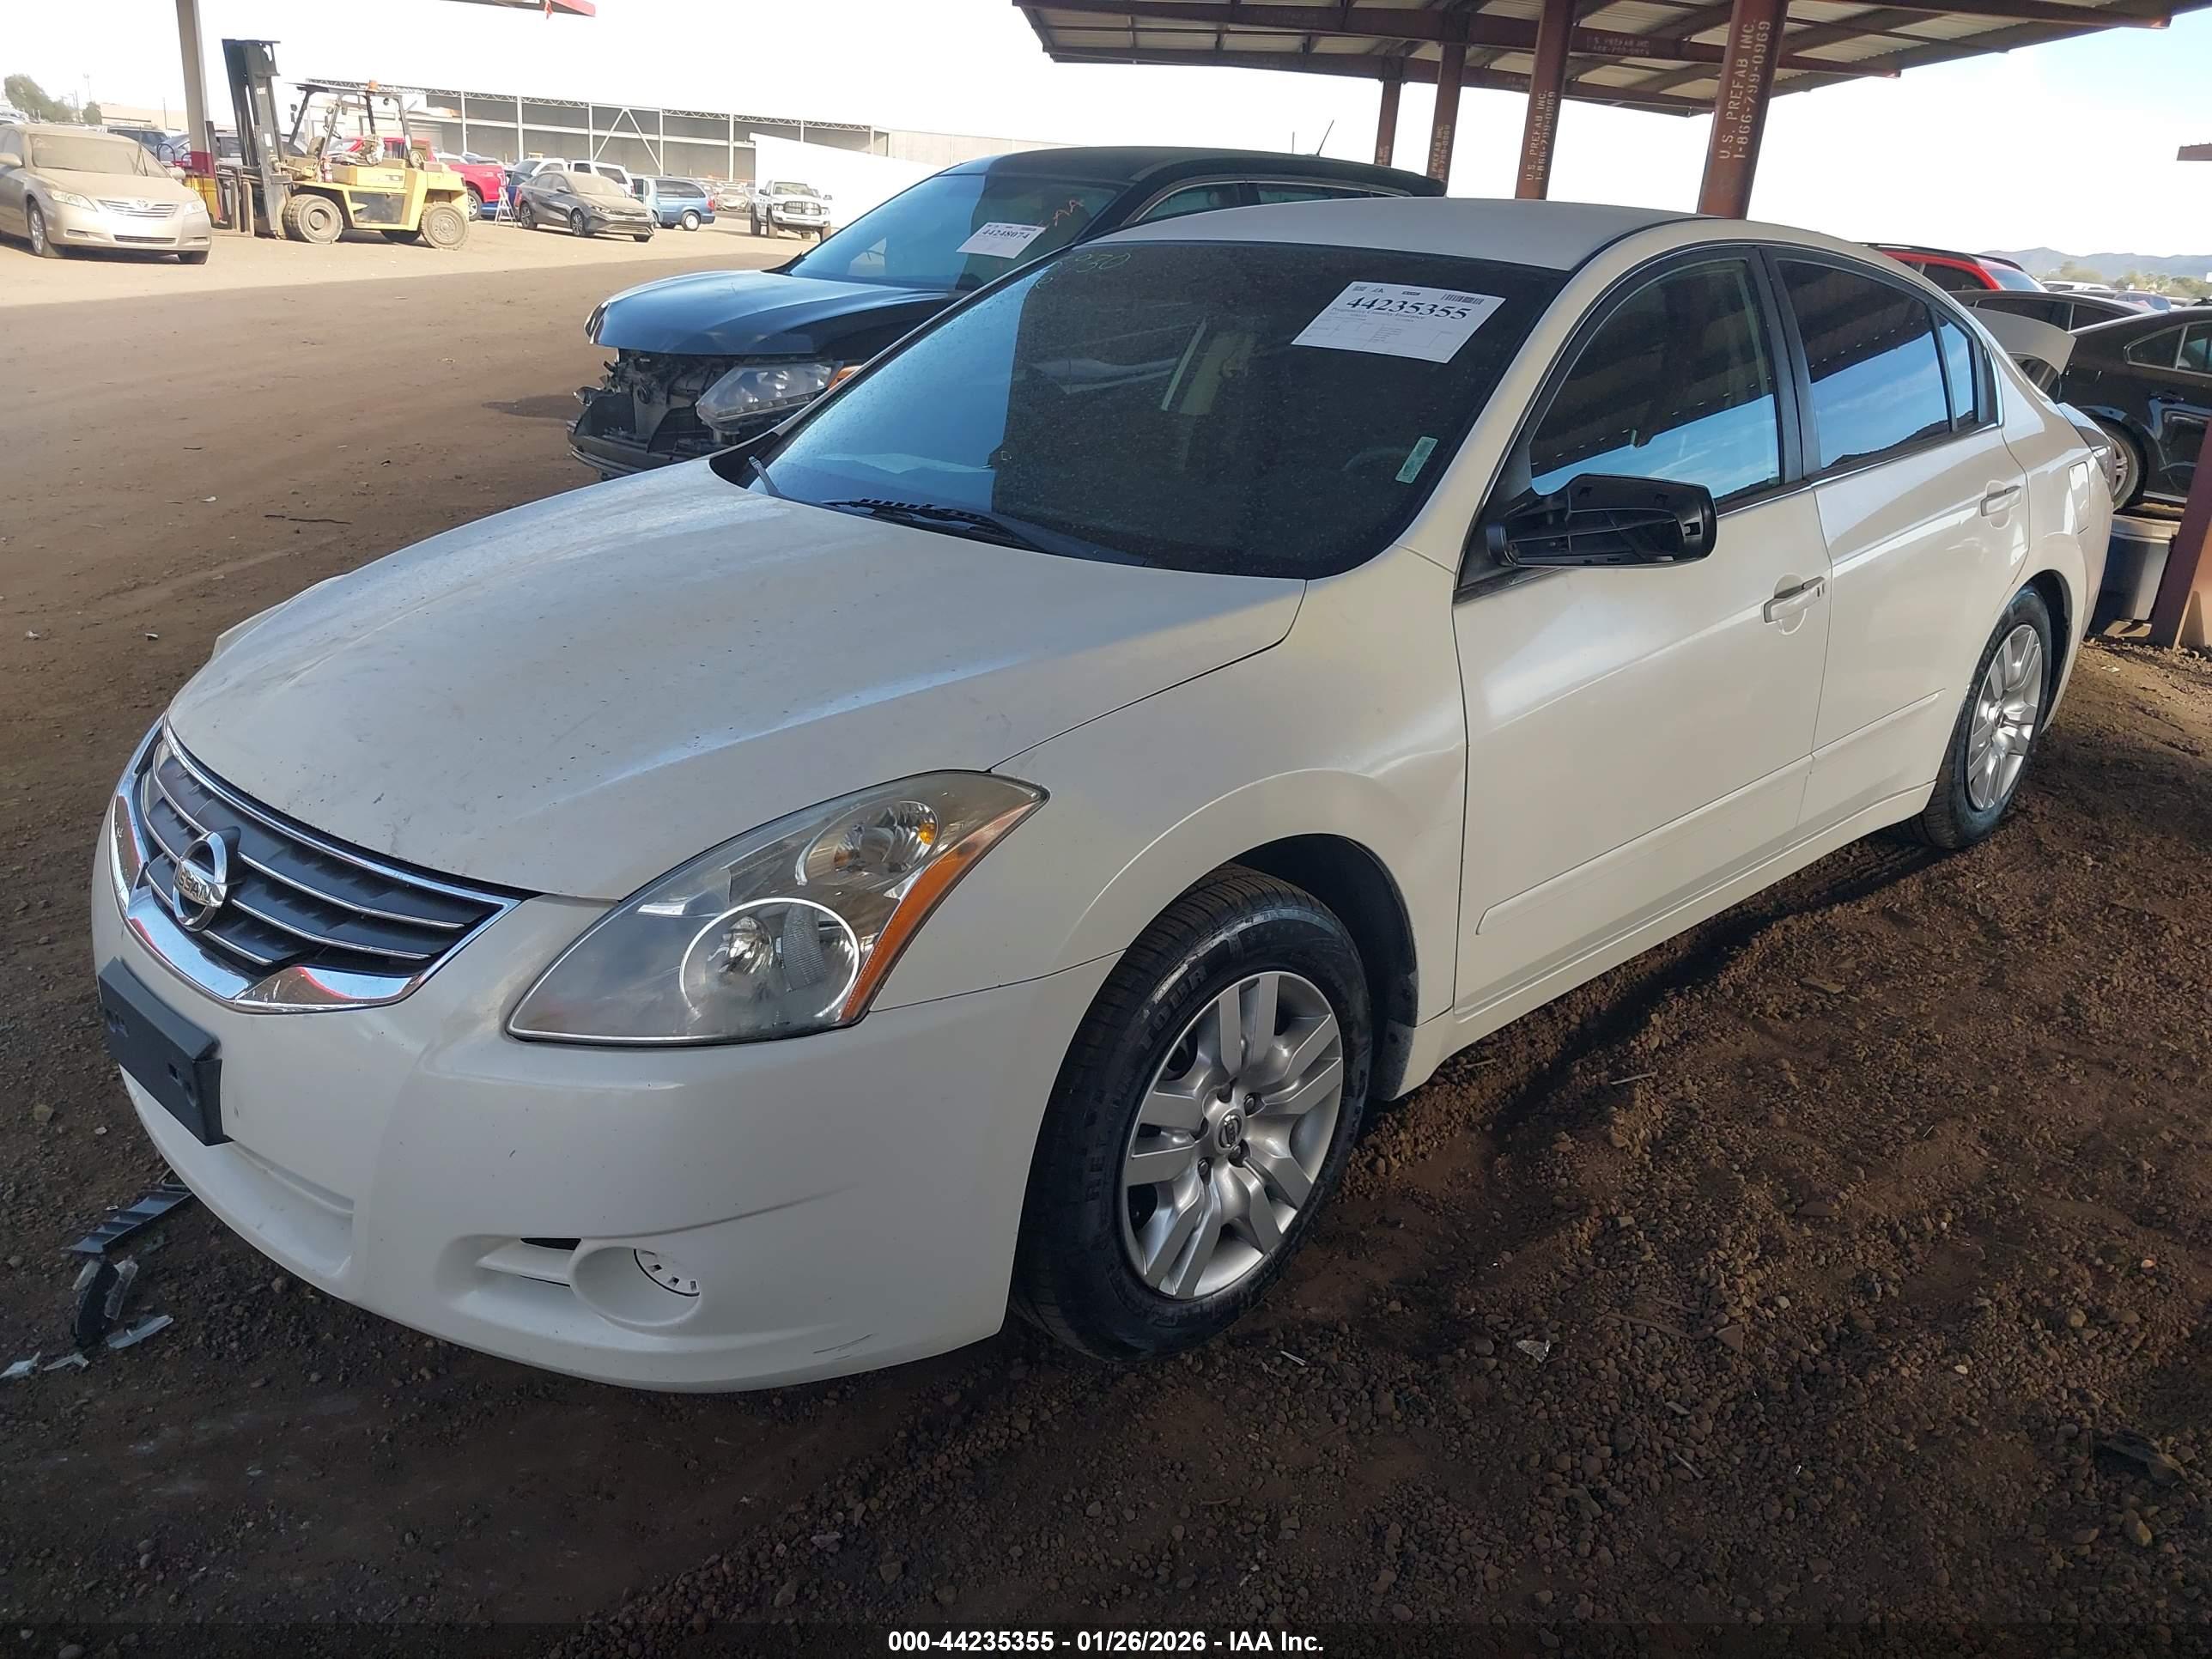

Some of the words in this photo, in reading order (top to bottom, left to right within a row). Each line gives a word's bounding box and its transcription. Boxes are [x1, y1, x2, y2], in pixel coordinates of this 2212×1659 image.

[1740, 20, 1757, 49] INC.
[1725, 58, 1749, 120] PREFAB
[1733, 21, 1771, 159] 1-866-799-0969
[1529, 115, 1543, 155] PREFAB
[1718, 130, 1735, 159] U.S.
[981, 228, 1030, 240] 44248074
[1346, 296, 1473, 320] 44235355
